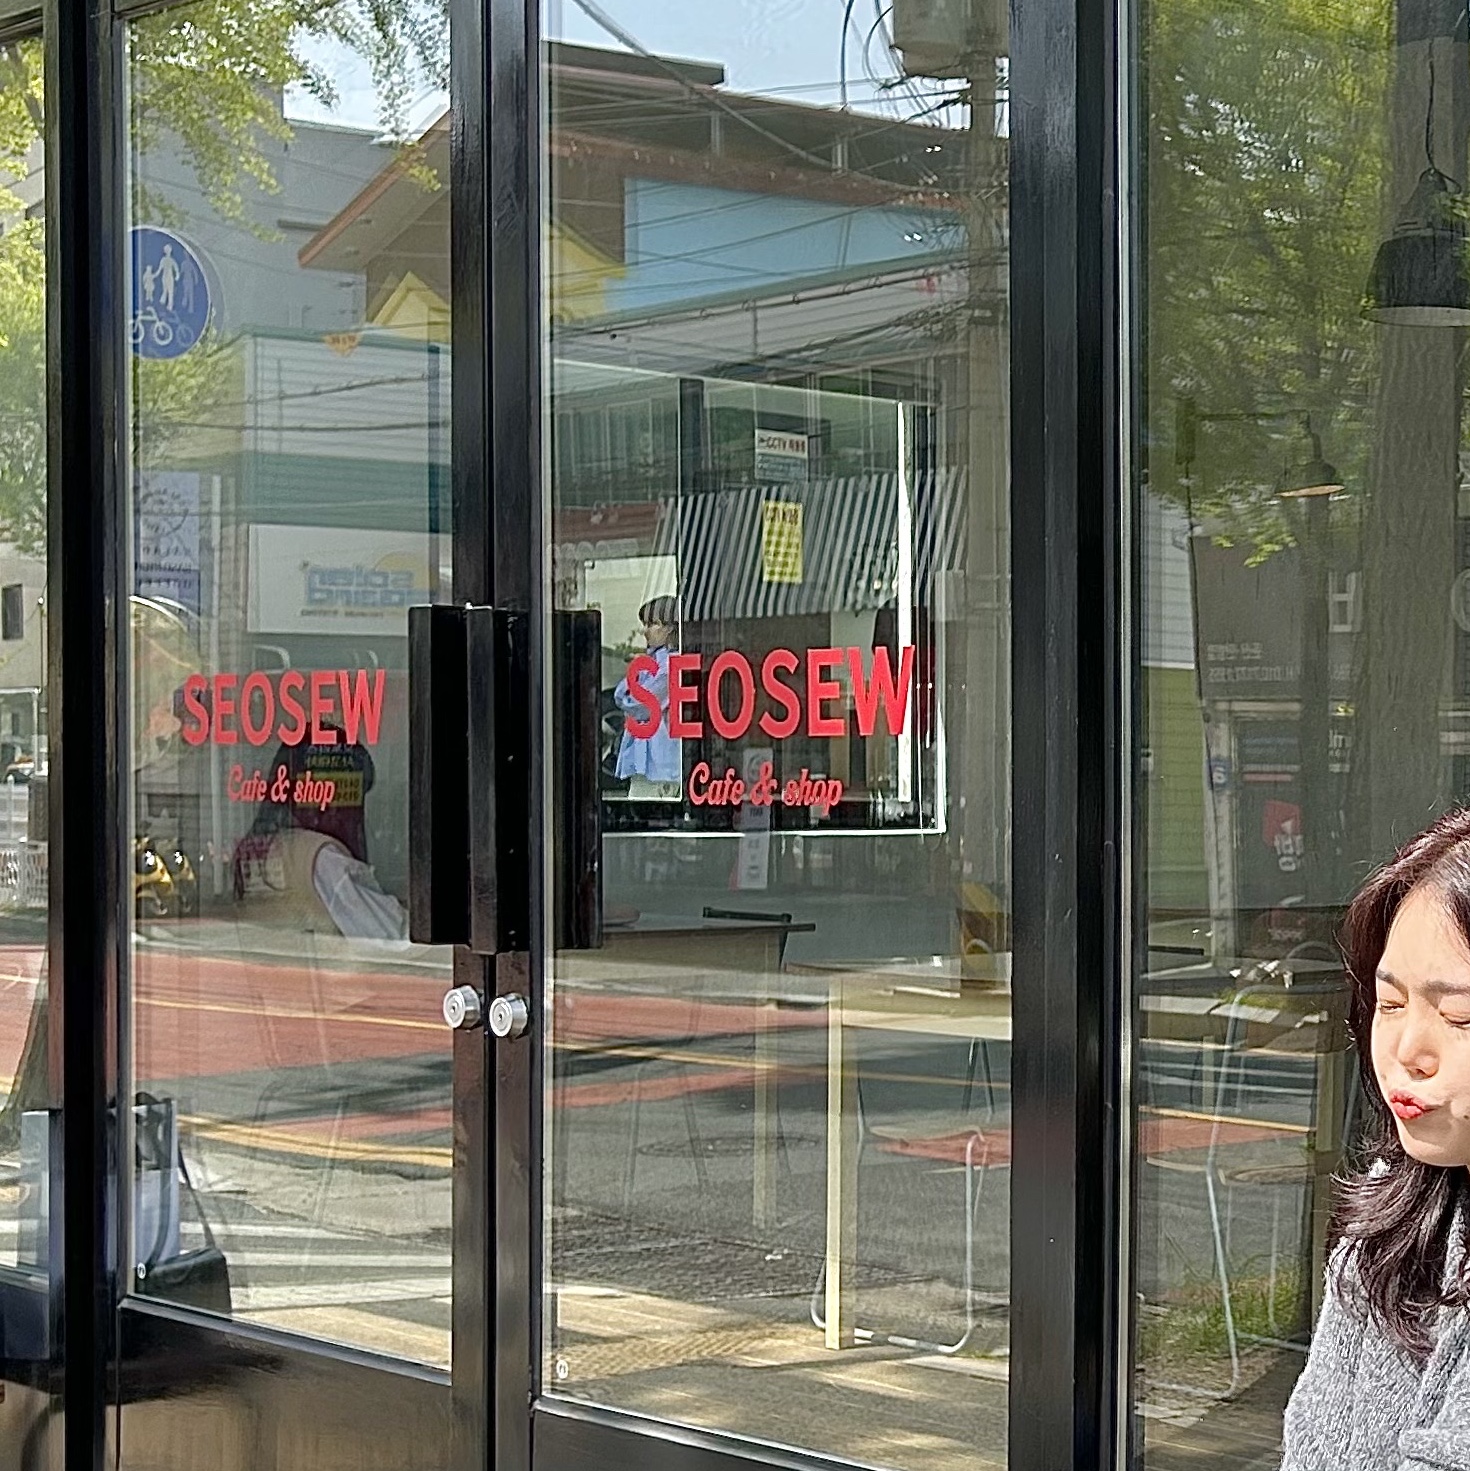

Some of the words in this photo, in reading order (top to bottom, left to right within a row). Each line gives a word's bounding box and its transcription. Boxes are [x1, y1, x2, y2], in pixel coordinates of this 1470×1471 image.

[182, 669, 386, 746] SEOSEW
[625, 645, 915, 739] SEOSEW
[227, 765, 267, 803] Cafe
[270, 764, 290, 802] &
[293, 770, 336, 811] shop
[688, 762, 744, 806] Cafe
[749, 761, 777, 806] &
[782, 768, 843, 817] shop
